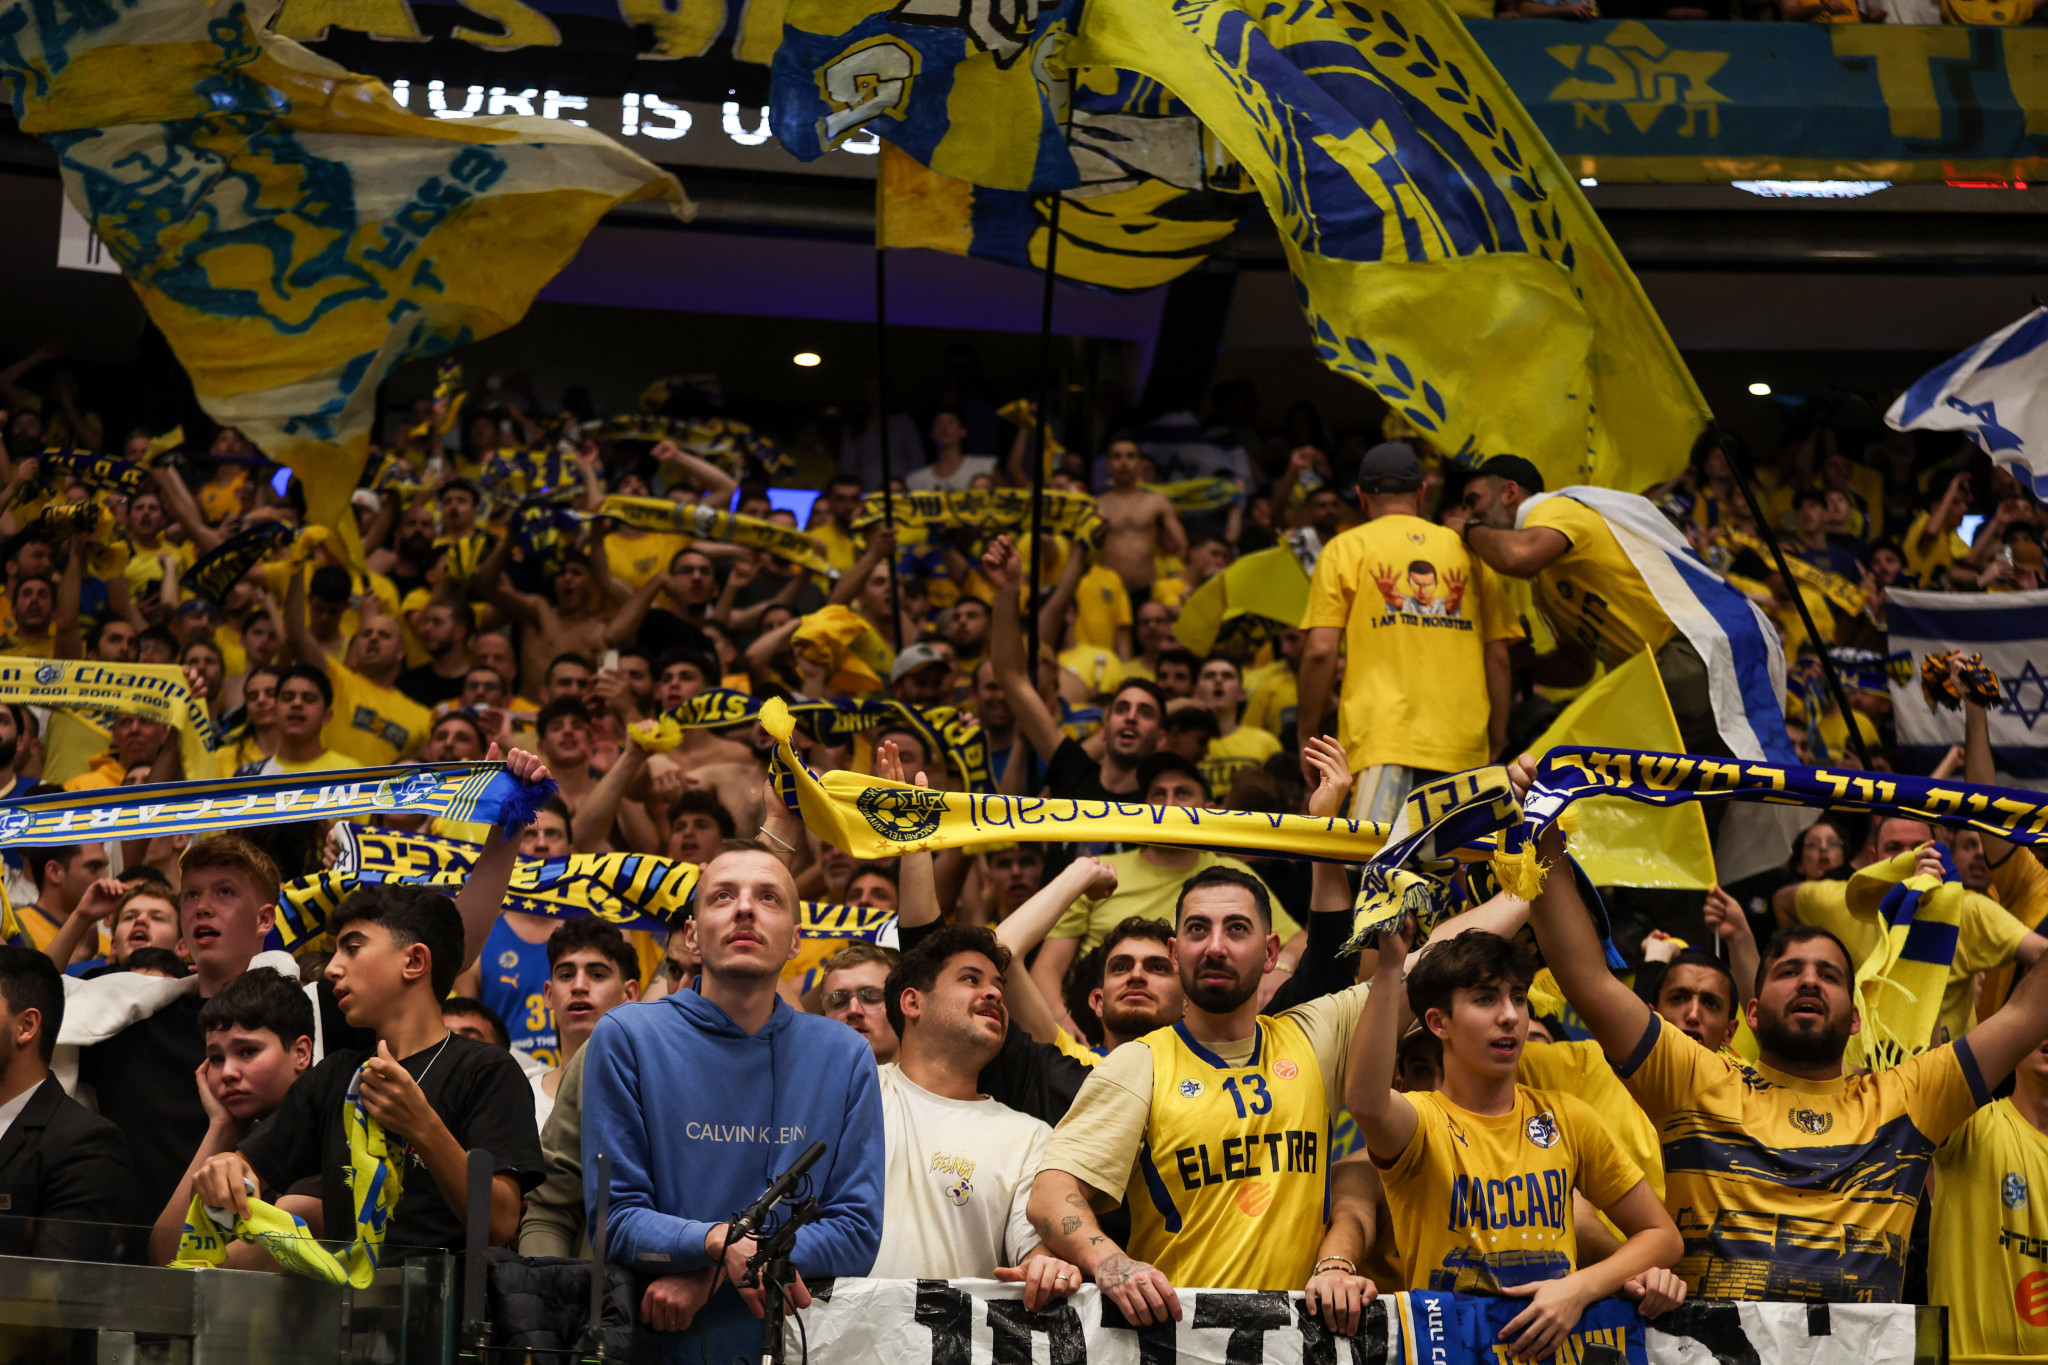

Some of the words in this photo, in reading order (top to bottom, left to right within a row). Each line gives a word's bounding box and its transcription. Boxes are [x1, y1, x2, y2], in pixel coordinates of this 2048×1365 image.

[391, 80, 590, 128] URE
[622, 93, 693, 140] IS
[1380, 615, 1396, 628] AM
[1400, 613, 1419, 626] THE
[1422, 617, 1474, 631] MONSTER
[30, 687, 67, 696] 2001
[79, 688, 121, 699] 2004
[808, 902, 889, 927] VIV
[1222, 1074, 1273, 1119] 13
[686, 1122, 758, 1143] CALVIN
[759, 1124, 806, 1145] KLEIN
[1176, 1131, 1317, 1191] ELECTRA
